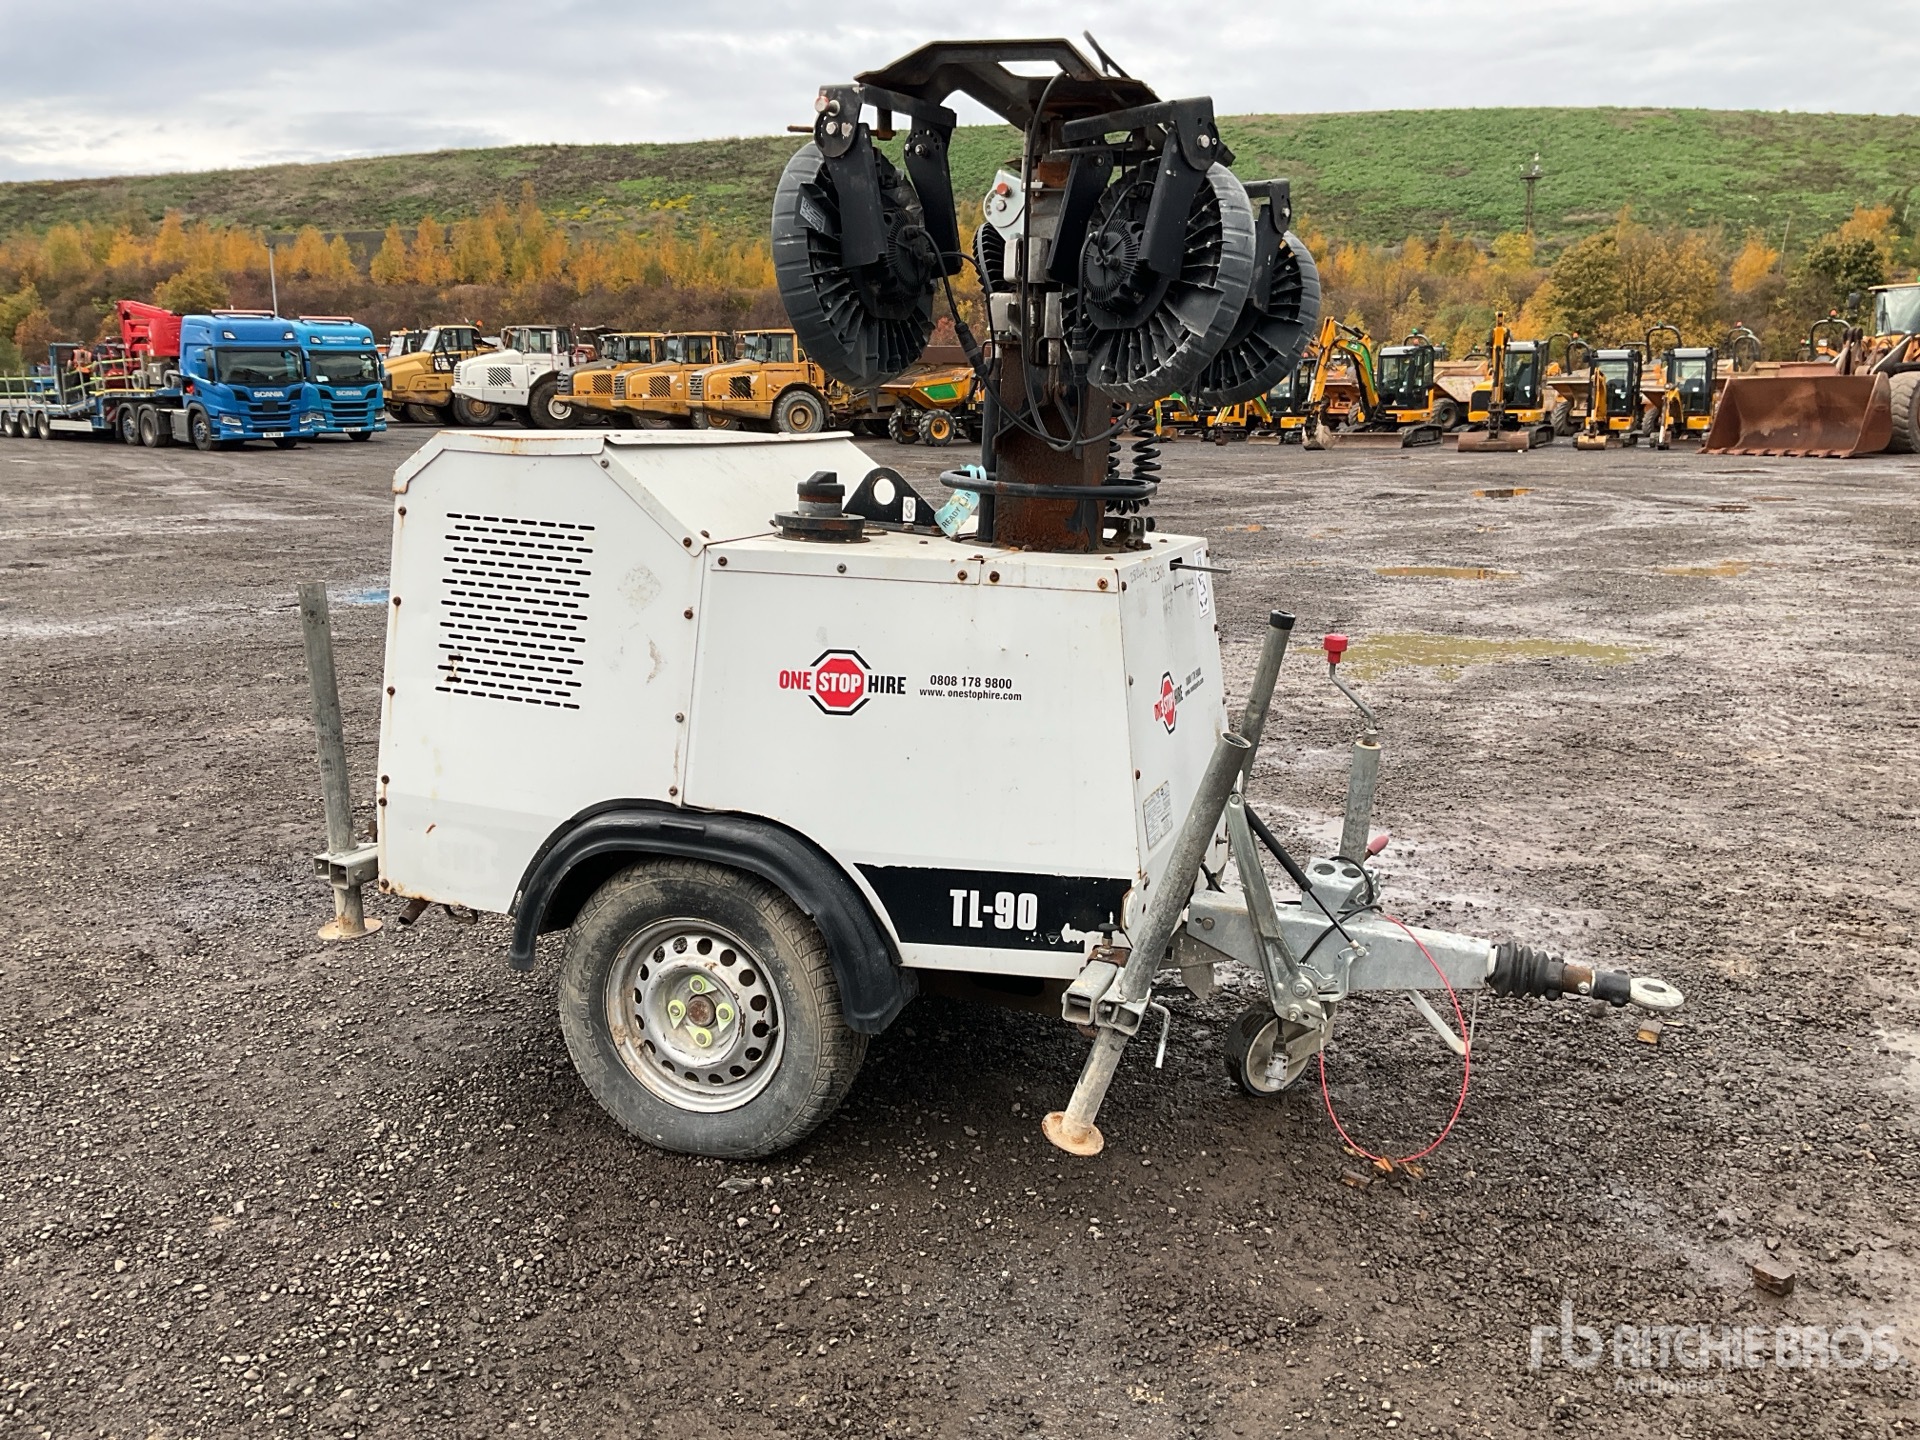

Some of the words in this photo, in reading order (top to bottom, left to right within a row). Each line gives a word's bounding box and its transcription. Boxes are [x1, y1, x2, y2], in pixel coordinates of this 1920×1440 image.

[941, 506, 961, 528] READY
[779, 669, 812, 691] ONE
[818, 672, 862, 694] STOP
[867, 675, 907, 695] HIRE
[930, 674, 958, 687] 0808
[961, 676, 982, 688] 178
[984, 677, 1013, 689] 9800
[919, 690, 946, 698] www.
[947, 689, 1022, 701] onestophire.com
[949, 888, 1038, 931] TL-90
